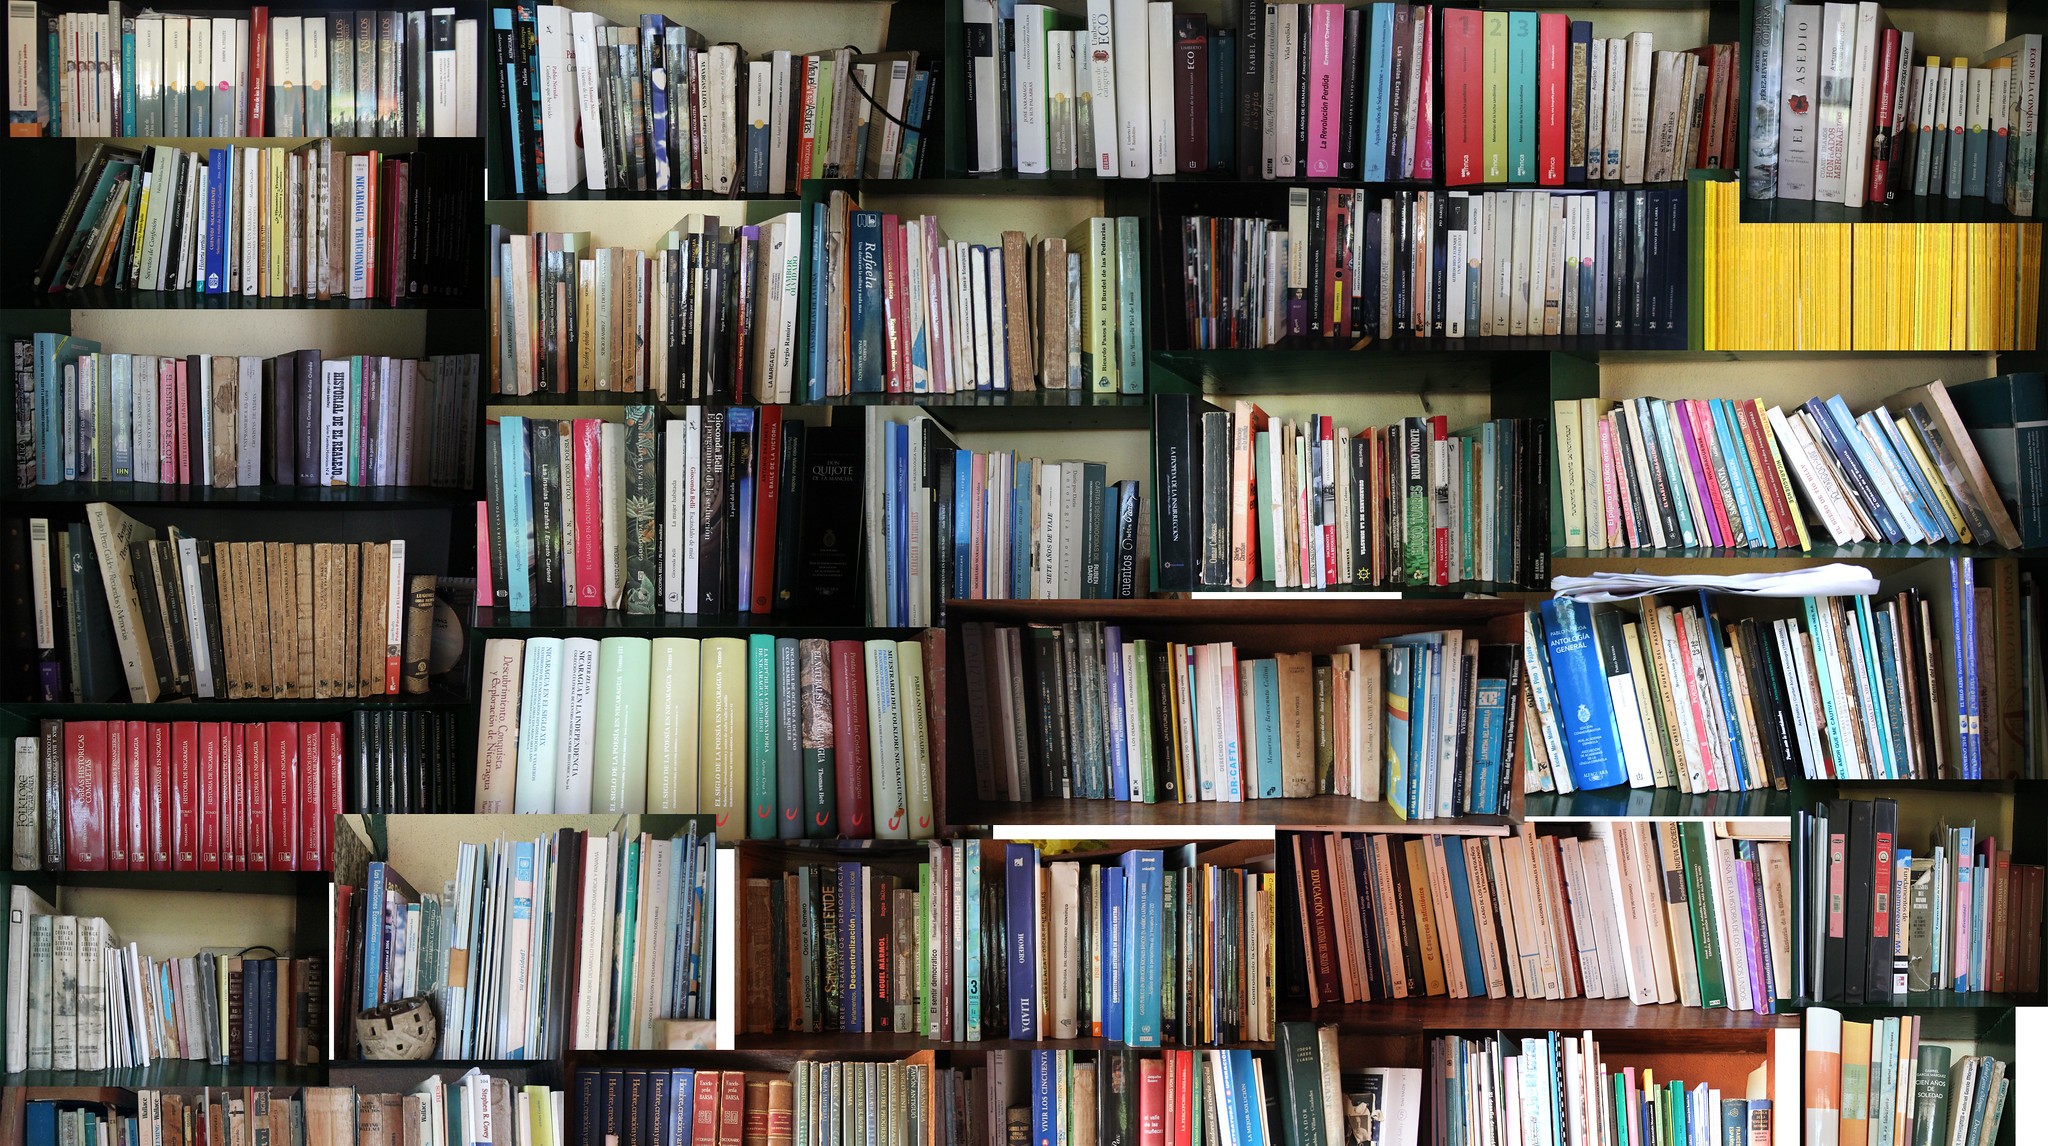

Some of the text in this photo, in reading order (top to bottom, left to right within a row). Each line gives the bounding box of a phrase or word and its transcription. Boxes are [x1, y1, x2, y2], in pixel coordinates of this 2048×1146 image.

[1097, 13, 1109, 44] ECO
[1246, 42, 1255, 74] ISABEL
[1759, 50, 1767, 100] PÉREZ-REVERTE
[1792, 22, 1807, 142] EL ASEDIO
[2028, 82, 2034, 91] LA
[2029, 70, 2035, 80] DE
[1319, 74, 1329, 148] La Revolución Perdida
[2025, 93, 2034, 136] CONQUISTA
[1825, 127, 1836, 178] HONRADOS
[1833, 112, 1844, 178] MERCENARIOS
[354, 176, 364, 280] NICARAGUA TRAICIONADA
[144, 256, 152, 280] Secretos
[148, 217, 157, 247] Confesión
[863, 242, 877, 288] Rafaela
[1100, 269, 1106, 277] de
[331, 372, 344, 476] HISTORIAL DE EL REALEJO
[707, 412, 714, 422] El
[1737, 410, 1747, 429] TOMO
[704, 425, 713, 472] pergamino
[714, 412, 722, 472] Gioconda Belli
[1410, 428, 1420, 478] RUMBO NORTE
[1743, 433, 1760, 468] Nicaragua
[706, 474, 713, 485] de
[812, 466, 852, 475] QUIJOTE
[1754, 468, 1762, 478] de
[1800, 462, 1842, 535] EL SUEÑO DE TÍO BILLY
[704, 498, 712, 539] seducción
[1768, 511, 1782, 541] Culturas
[94, 510, 106, 532] Benito
[108, 573, 121, 603] Recuerdos
[116, 609, 129, 640] Memorias
[1120, 555, 1132, 595] cuentos
[1550, 631, 1589, 646] ANTOLOGÍA
[1647, 608, 1658, 645] PASATIEMPO
[1555, 641, 1586, 654] GENERAL
[1659, 662, 1667, 687] PUERTAS
[715, 713, 721, 722] EN
[714, 751, 721, 760] LA
[714, 762, 721, 771] DE
[1228, 741, 1237, 794] DR-CAFTA
[1676, 750, 1685, 776] ALFONSO
[16, 775, 28, 827] FOLKLORE
[714, 797, 720, 806] EL
[1901, 867, 1909, 911] Fundamentos
[821, 886, 837, 992] Salvador ALLENDE
[1722, 848, 1746, 1001] RESEÑA DE LA HISTORIA DE LOS ESTADOS UNIDOS
[848, 918, 856, 989] Descentralización
[877, 937, 885, 969] MÁRMOL
[1017, 933, 1025, 963] HOMERO
[1895, 940, 1900, 953] MX
[518, 949, 526, 982] diversidad?
[970, 980, 976, 993] 3
[1020, 998, 1031, 1031] ILIADA
[480, 1088, 488, 1111] Stephen
[481, 1120, 489, 1138] Covey
